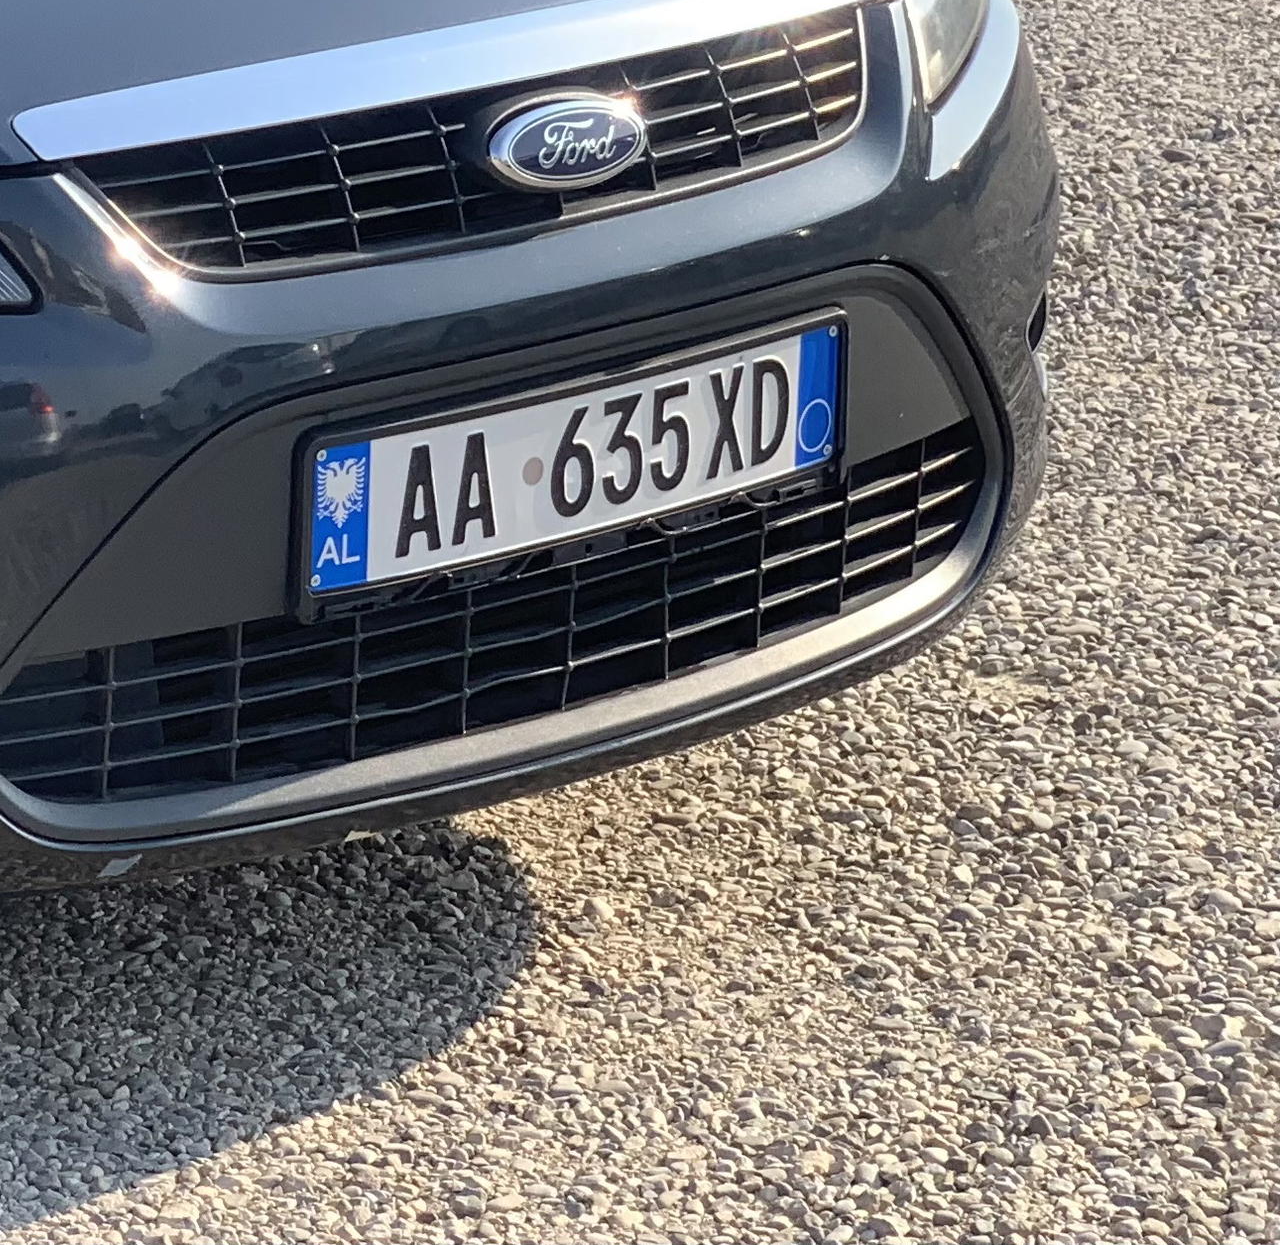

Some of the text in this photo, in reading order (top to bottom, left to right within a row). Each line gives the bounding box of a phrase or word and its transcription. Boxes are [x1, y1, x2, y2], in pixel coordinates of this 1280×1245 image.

[539, 118, 617, 170] Ford
[395, 355, 790, 558] AA 635 XD
[316, 536, 360, 569] AL
